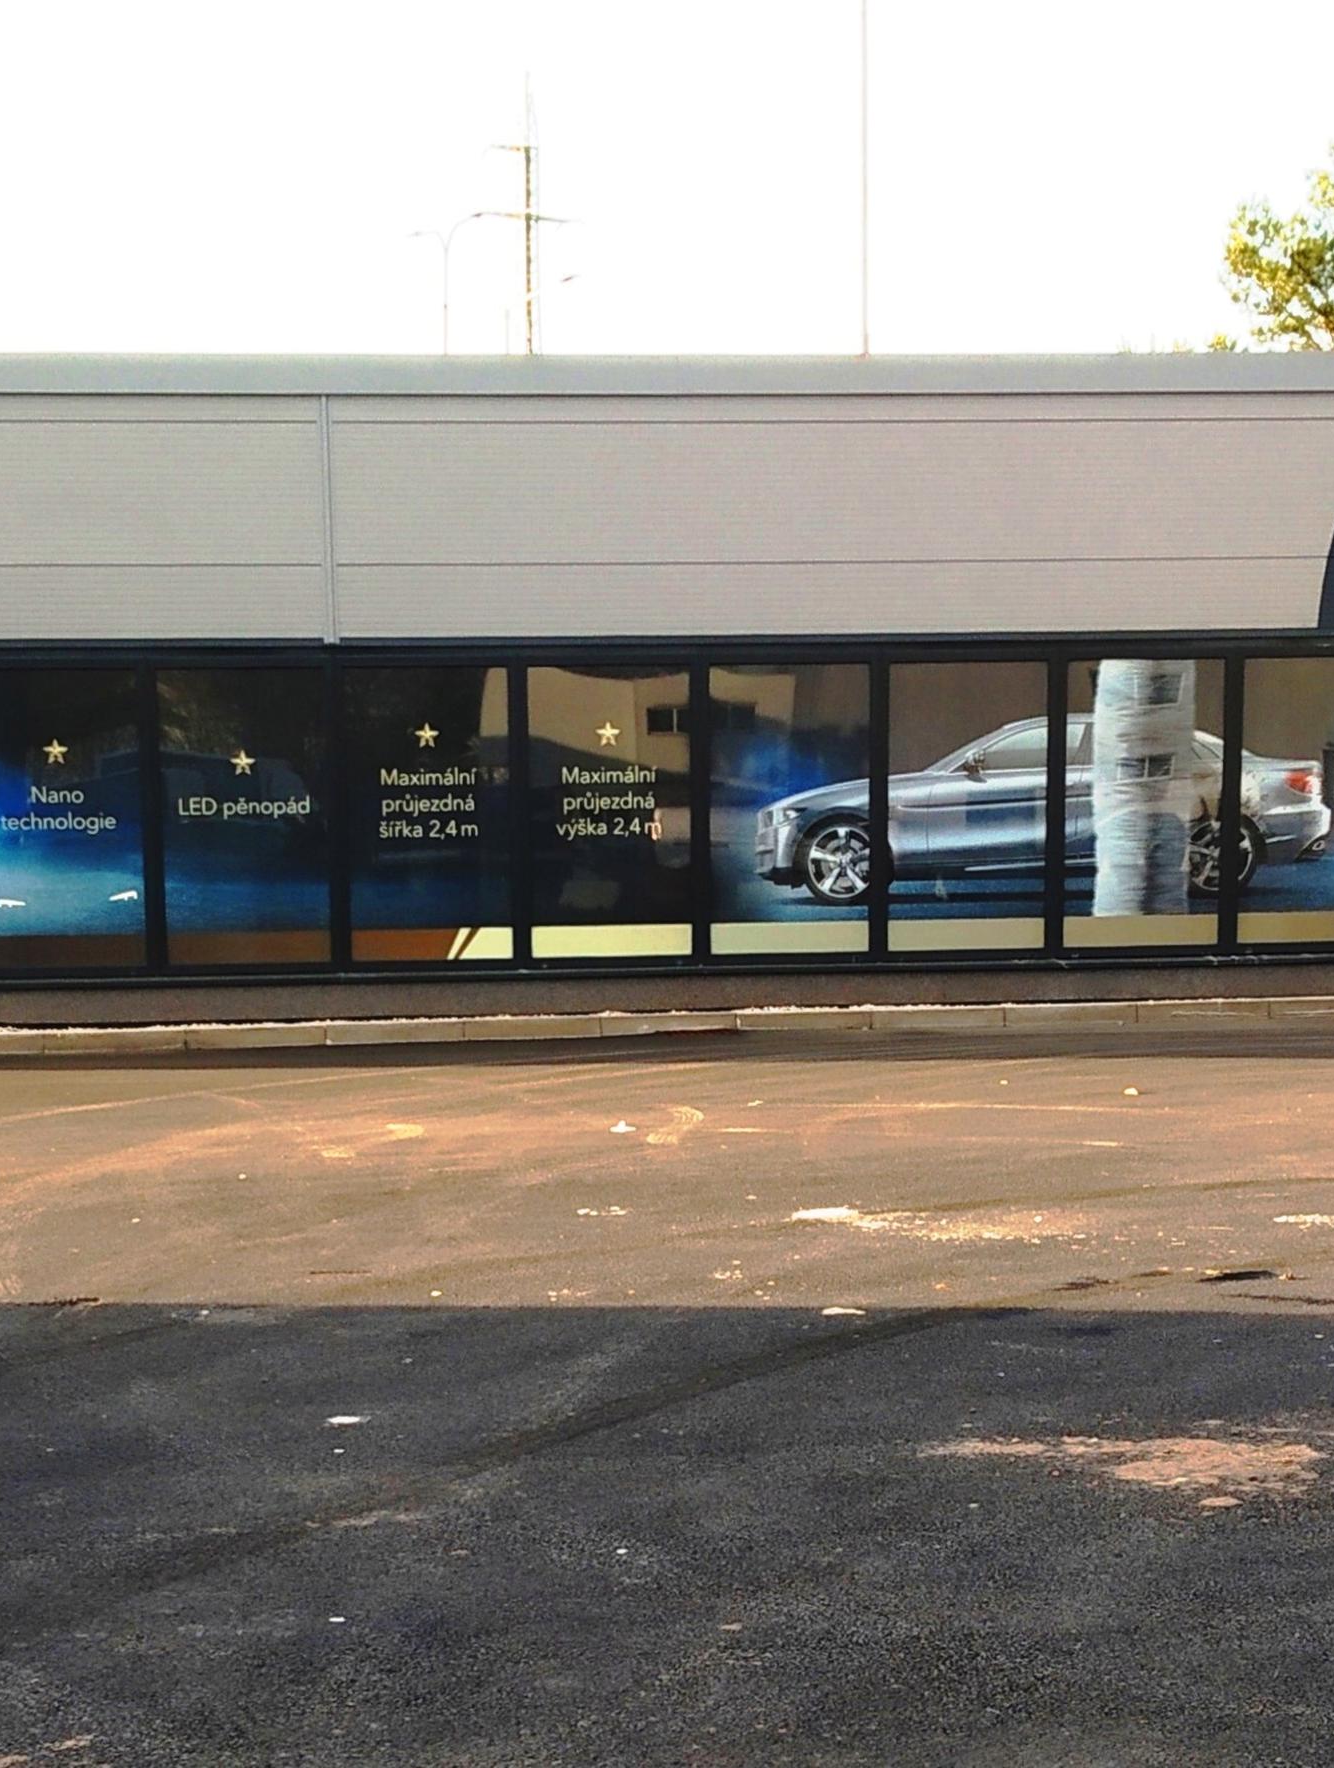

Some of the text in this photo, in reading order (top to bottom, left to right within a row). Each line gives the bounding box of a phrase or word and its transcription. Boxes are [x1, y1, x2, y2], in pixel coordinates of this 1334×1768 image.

[380, 767, 475, 787] Maximální
[561, 765, 657, 785] Maximální
[31, 786, 85, 805] Nano
[381, 791, 475, 815] průjezdná
[562, 789, 656, 814] průjezdná
[178, 795, 311, 819] LED pěnopád
[0, 812, 117, 834] technologie
[379, 818, 423, 838] šířka
[555, 817, 608, 841] výška
